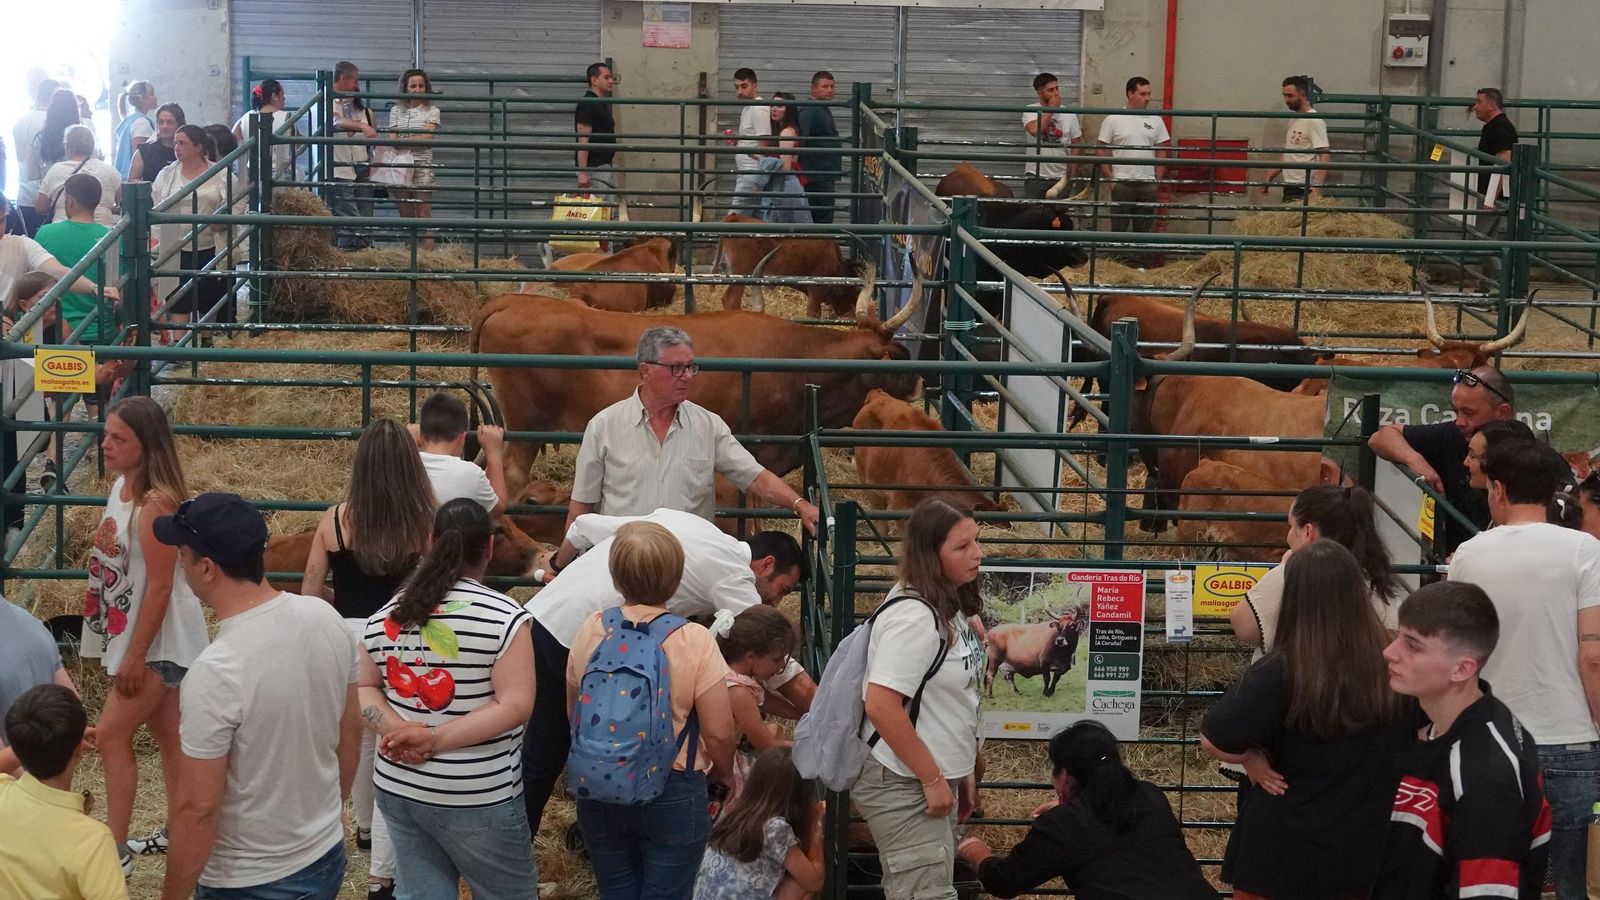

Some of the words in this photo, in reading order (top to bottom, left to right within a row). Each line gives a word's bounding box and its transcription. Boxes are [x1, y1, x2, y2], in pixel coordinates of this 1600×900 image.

[47, 361, 83, 371] GALBIS
[1343, 397, 1411, 426] Rza
[1420, 403, 1552, 431] Cana
[1210, 580, 1252, 590] GALBIS
[1097, 594, 1124, 602] Rebeca
[1096, 602, 1119, 610] Yáñez
[1096, 611, 1132, 619] Candamil
[1092, 698, 1135, 713] Cachega
